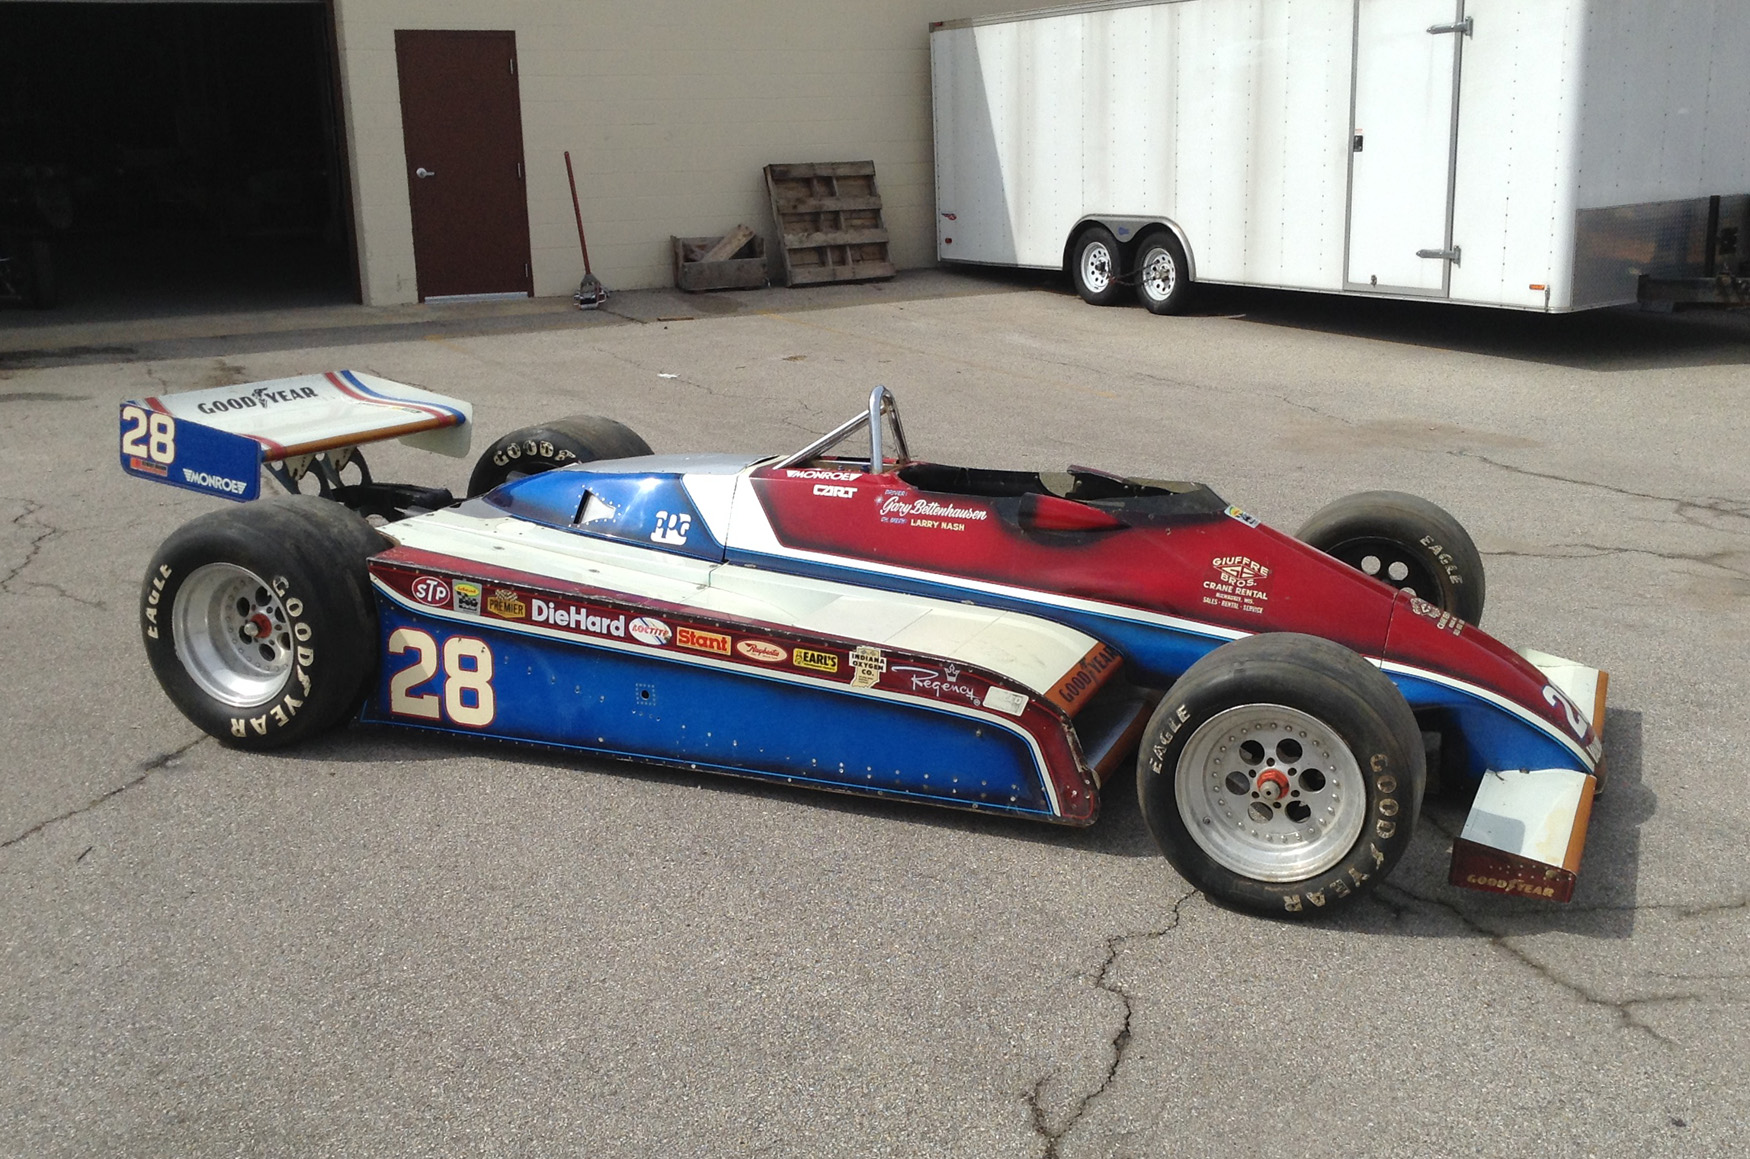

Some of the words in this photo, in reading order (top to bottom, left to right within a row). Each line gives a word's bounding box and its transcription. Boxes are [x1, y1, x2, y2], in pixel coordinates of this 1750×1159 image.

[122, 406, 175, 464] 28
[186, 470, 243, 494] MONROE
[790, 470, 857, 481] MONROE
[813, 484, 858, 498] CART
[880, 496, 912, 516] Gary
[909, 499, 987, 520] Bettenhausen
[910, 519, 939, 529] LARRY
[941, 522, 965, 531] NASH
[1212, 556, 1270, 577] GIUFFRE
[1419, 535, 1463, 586] EAGLE
[1221, 572, 1257, 587] BROS.
[416, 580, 447, 602] STP
[1203, 581, 1233, 593] CRANE
[1235, 587, 1268, 600] RENTAL
[144, 563, 173, 640] EAGLE
[489, 599, 524, 615] PREMIER
[532, 599, 625, 637] DieHard
[678, 629, 728, 652] Stant
[803, 652, 837, 667] EARL'S
[851, 653, 885, 664] INDIANA
[852, 661, 884, 671] OXYGEN
[388, 626, 496, 727] 28
[861, 668, 875, 676] CO.
[891, 666, 977, 701] Regency
[1151, 704, 1191, 775] EAGLE
